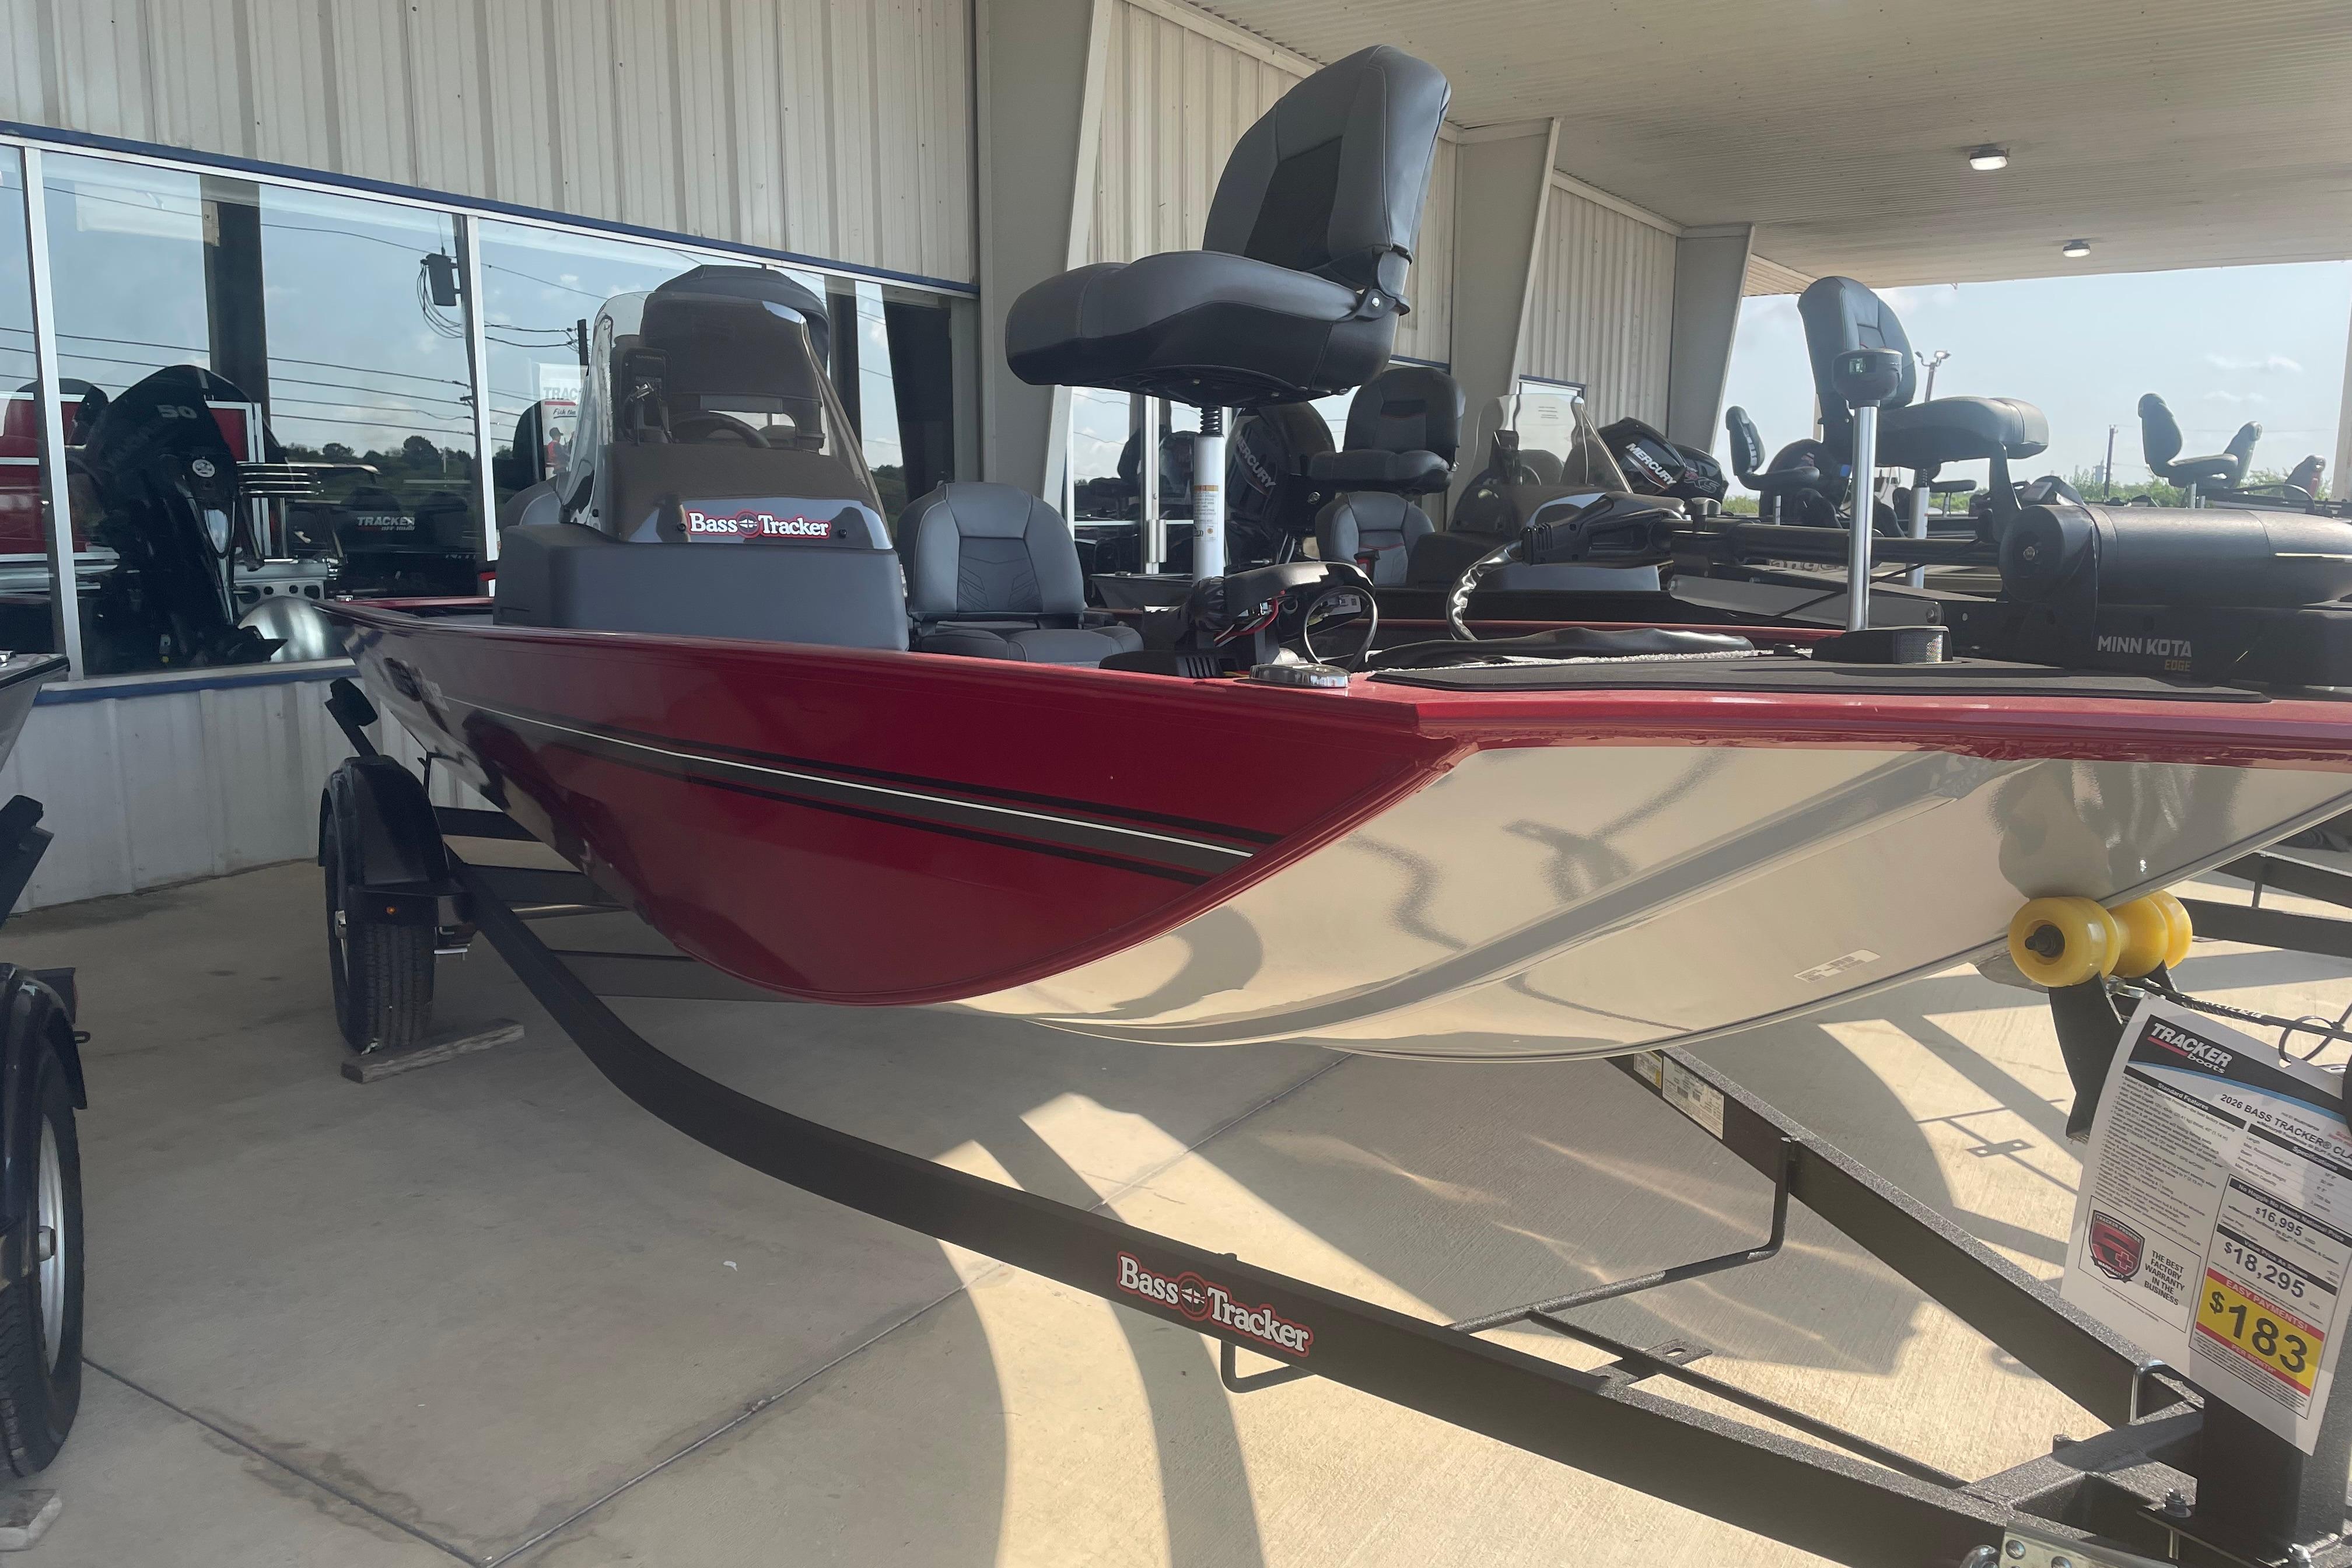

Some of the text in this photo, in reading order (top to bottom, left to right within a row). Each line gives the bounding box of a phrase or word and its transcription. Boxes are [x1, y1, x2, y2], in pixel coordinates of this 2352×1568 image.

[157, 404, 197, 419] 50
[1625, 443, 1677, 485] MERCURY
[356, 516, 415, 526] TRACKER
[689, 512, 829, 536] Bass Tracker
[2097, 635, 2192, 657] MINN KOTA
[2164, 659, 2192, 671] EDGE
[2151, 1021, 2232, 1069] TRACKER
[2186, 1052, 2225, 1074] boats
[2158, 1083, 2208, 1111] Standard Features
[2220, 1093, 2243, 1110] 2026
[2244, 1103, 2273, 1124] BASS
[2292, 1146, 2338, 1172] Specifications
[2255, 1207, 2305, 1237] $16,995
[2270, 1200, 2278, 1208] No
[2327, 1229, 2344, 1242] Price
[2150, 1258, 2182, 1281] FACTORY
[2151, 1250, 2184, 1274] THE BEST
[2224, 1242, 2305, 1298] $18,295
[2261, 1249, 2276, 1261] Price
[2278, 1258, 2286, 1266] As
[2144, 1264, 2185, 1292] WARRANTY
[2151, 1276, 2174, 1294] IN THE
[1119, 1256, 1310, 1352] Bass Tracker
[2144, 1280, 2179, 1306] BUSINESS
[2225, 1279, 2252, 1298] EASY
[2253, 1294, 2308, 1331] PAYMENTS!
[2209, 1291, 2308, 1374] $183
[2231, 1343, 2246, 1356] PER
